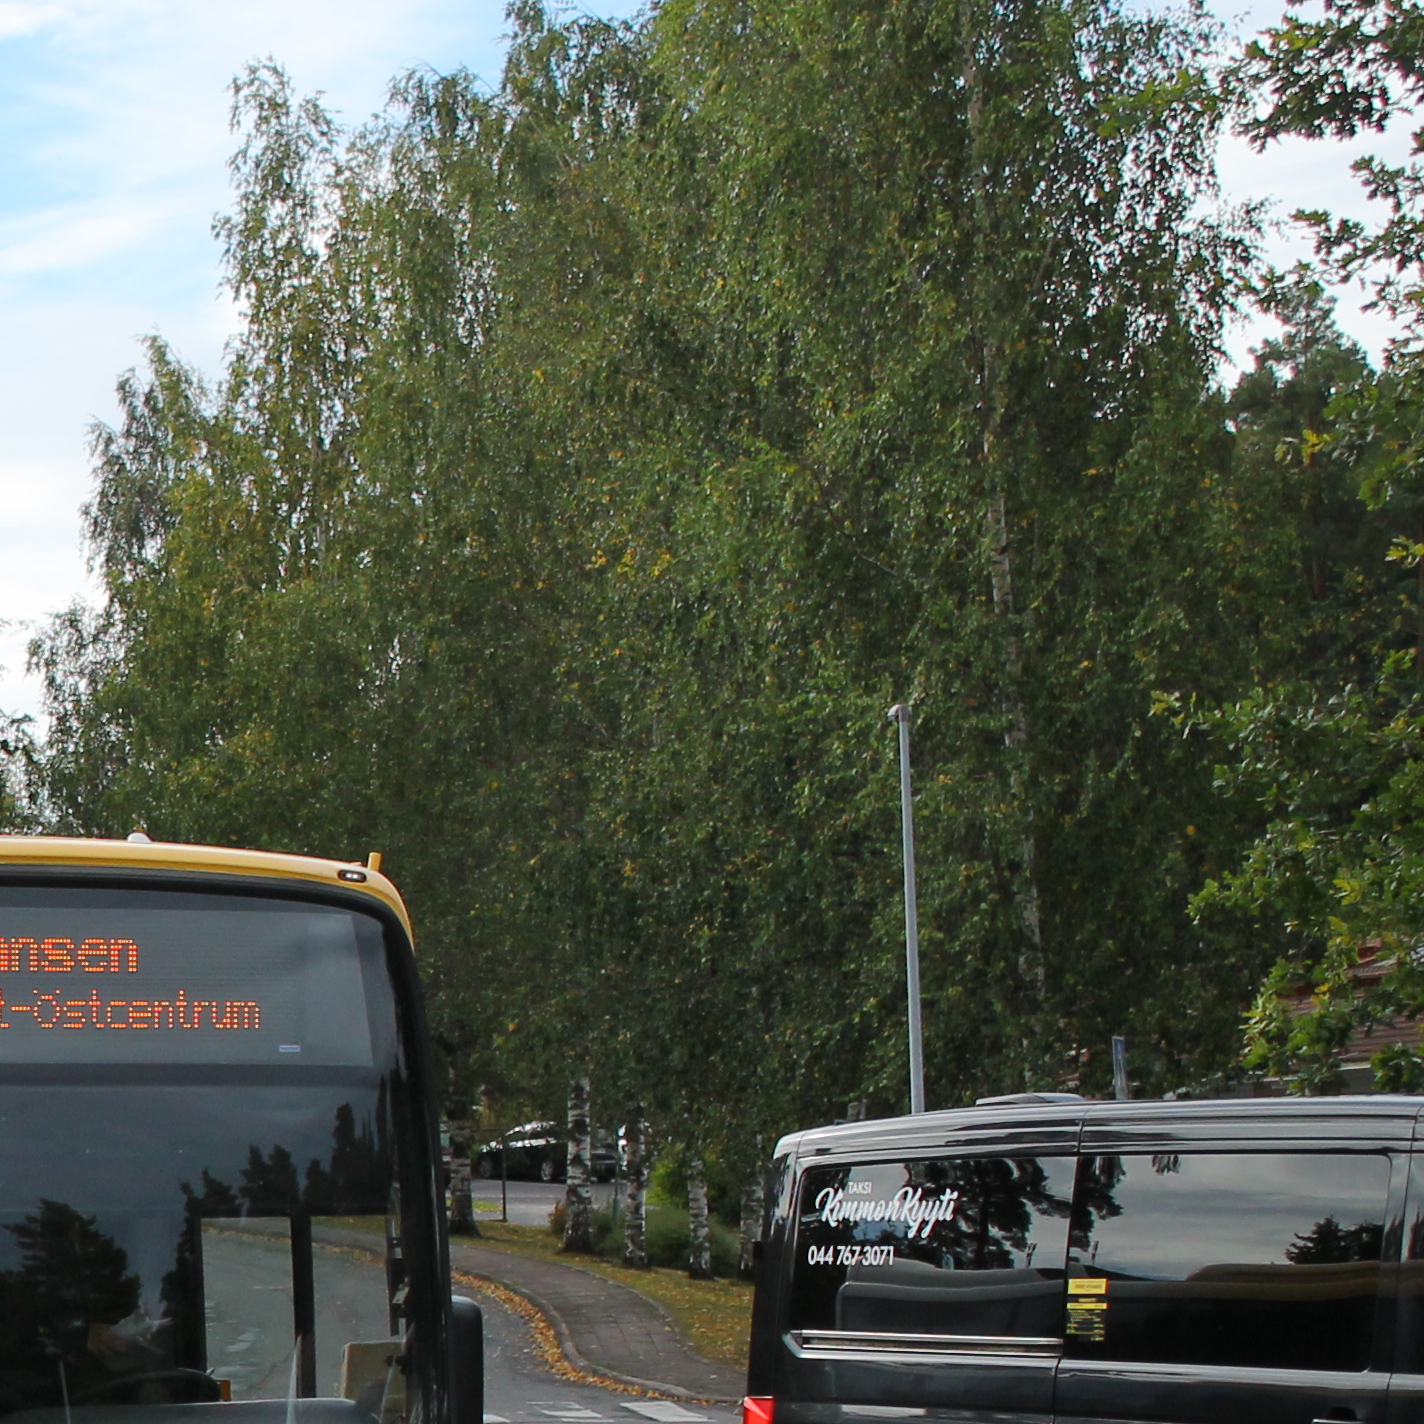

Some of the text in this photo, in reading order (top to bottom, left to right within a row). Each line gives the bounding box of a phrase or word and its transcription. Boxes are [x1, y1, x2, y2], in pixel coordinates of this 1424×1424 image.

[848, 1181, 872, 1194] TAKSI
[807, 1245, 895, 1266] 044 767 3071
